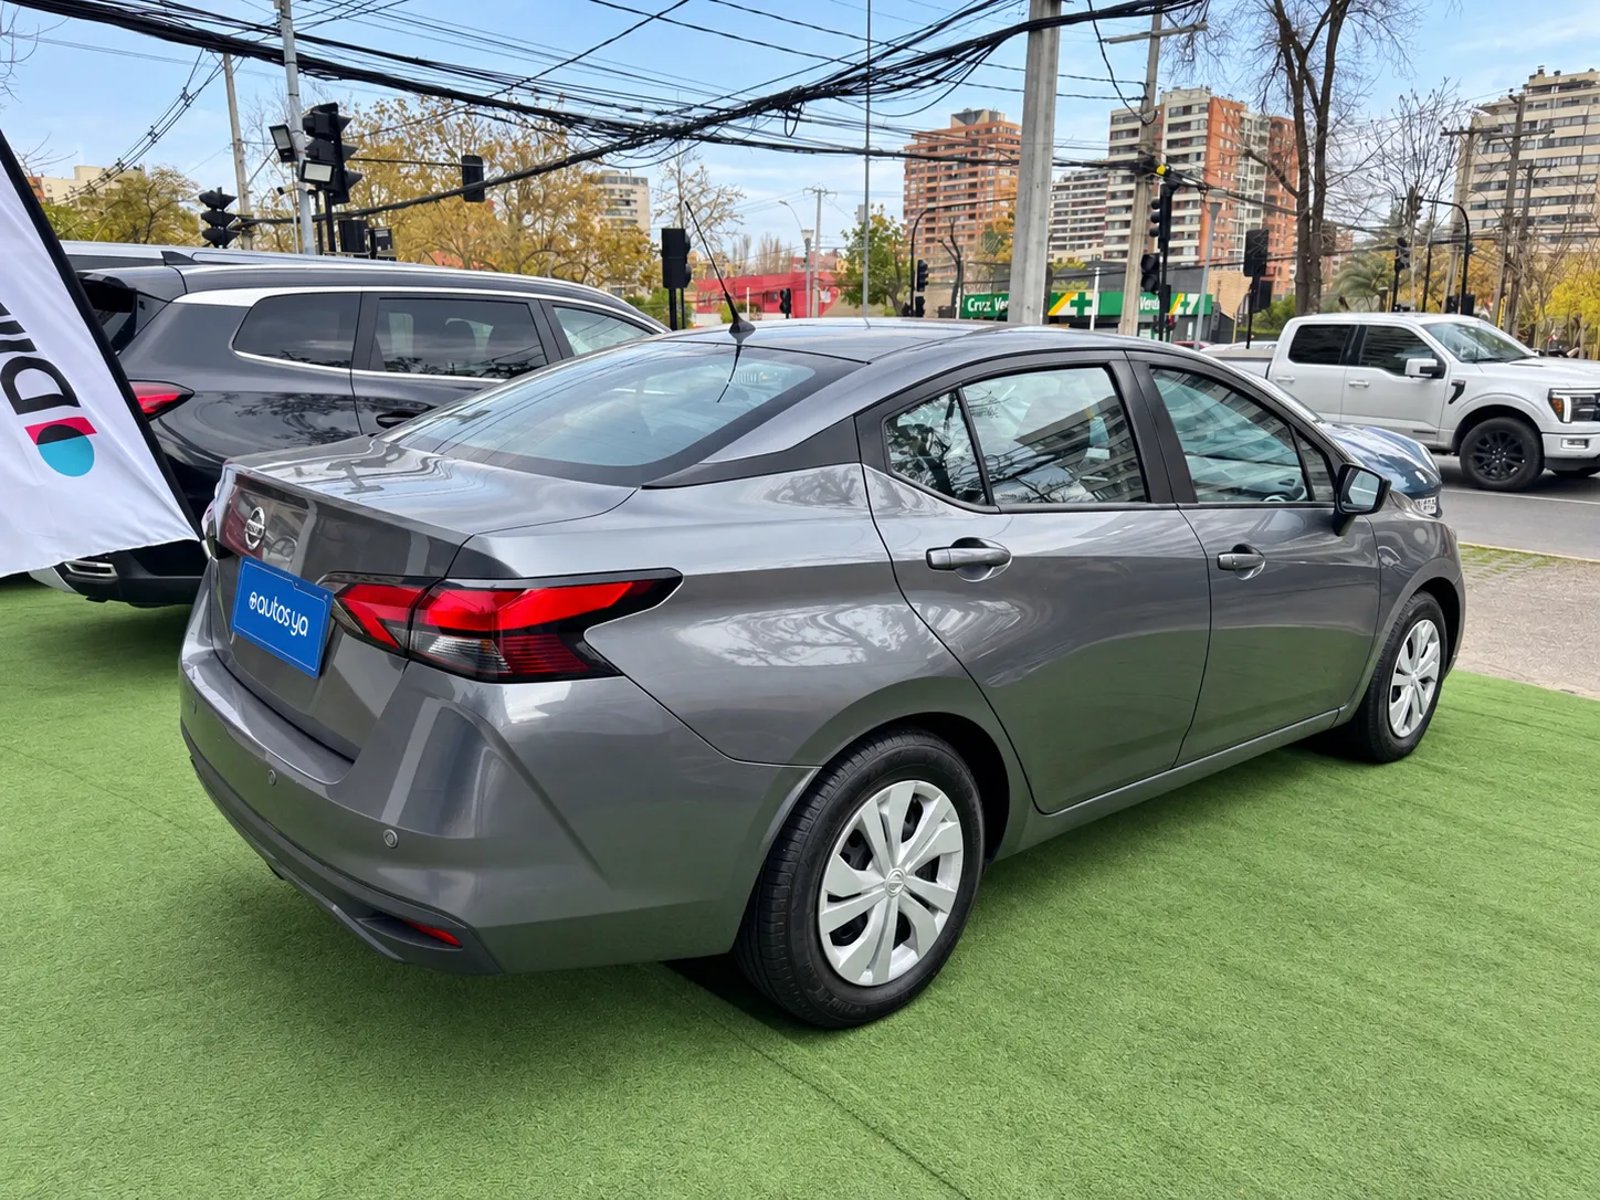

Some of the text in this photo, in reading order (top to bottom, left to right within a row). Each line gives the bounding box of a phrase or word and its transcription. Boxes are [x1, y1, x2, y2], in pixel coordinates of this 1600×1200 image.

[968, 297, 1009, 312] Cruz Ver
[1140, 295, 1160, 310] Verd
